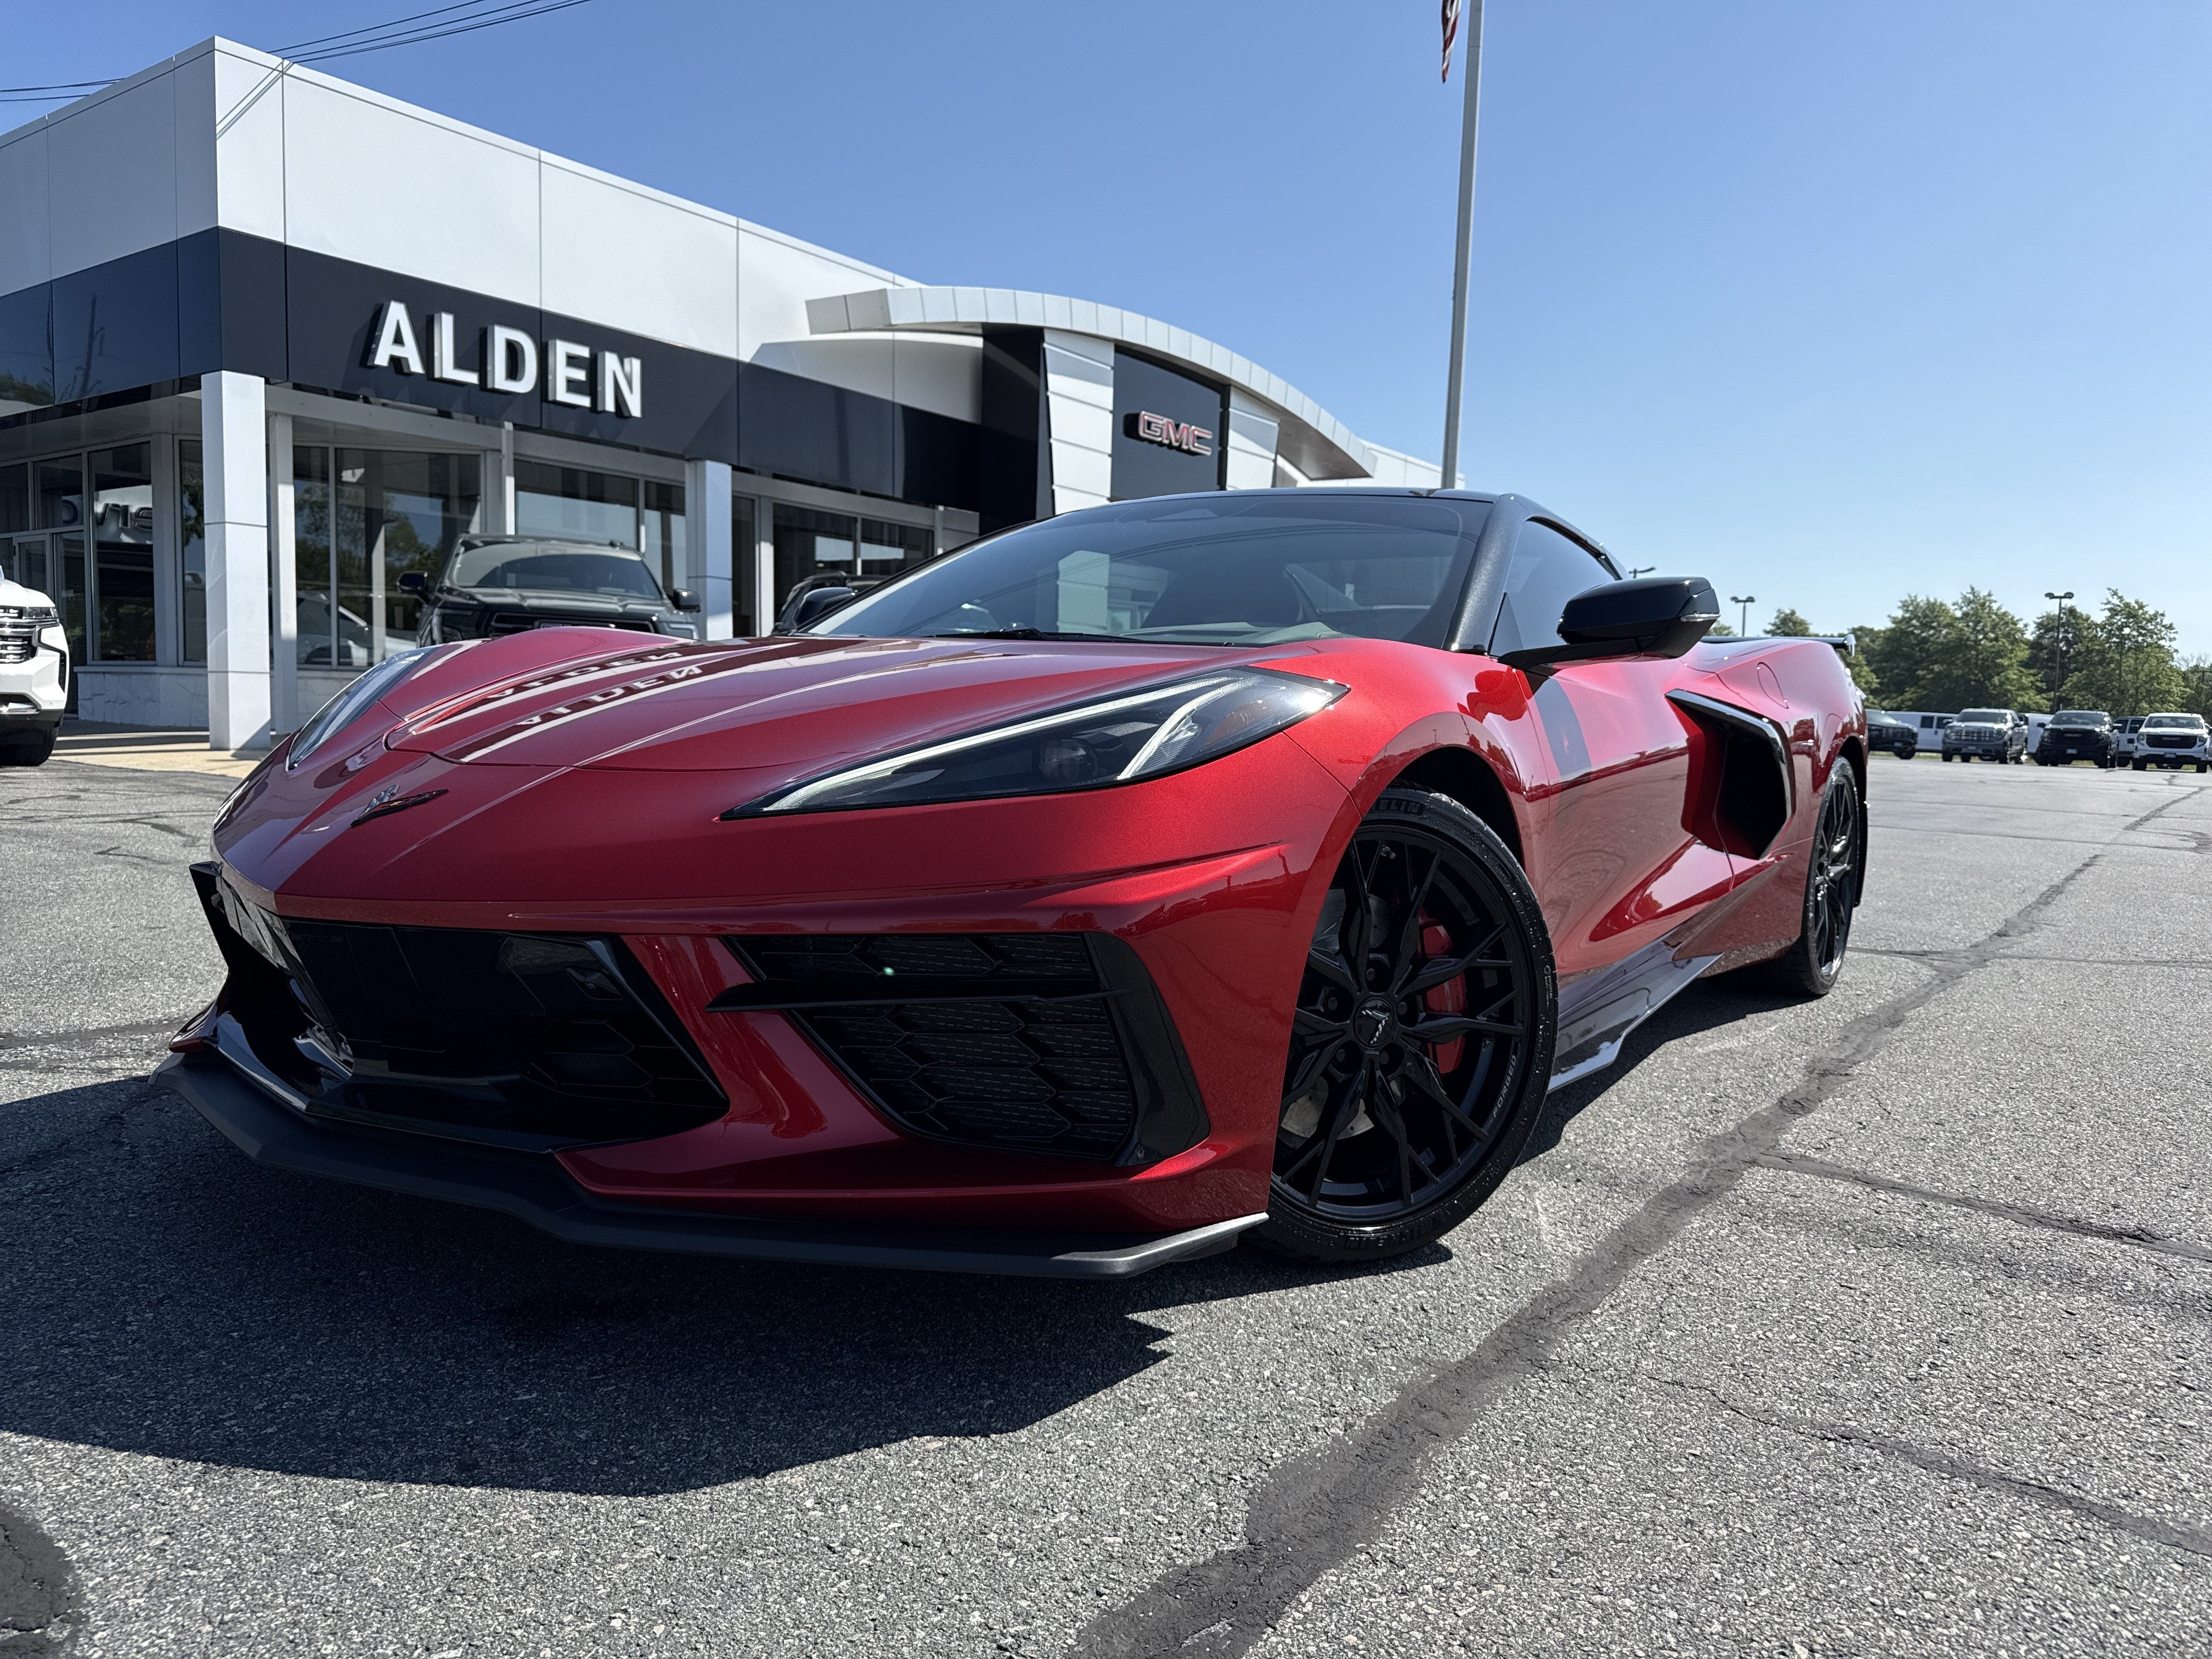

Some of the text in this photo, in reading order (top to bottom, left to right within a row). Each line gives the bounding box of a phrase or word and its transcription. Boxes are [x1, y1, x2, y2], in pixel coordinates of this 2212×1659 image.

[371, 299, 642, 418] ALDEN
[1138, 410, 1212, 456] GMC
[1372, 799, 1420, 814] ELIN
[1493, 1054, 1517, 1118] FORGED
